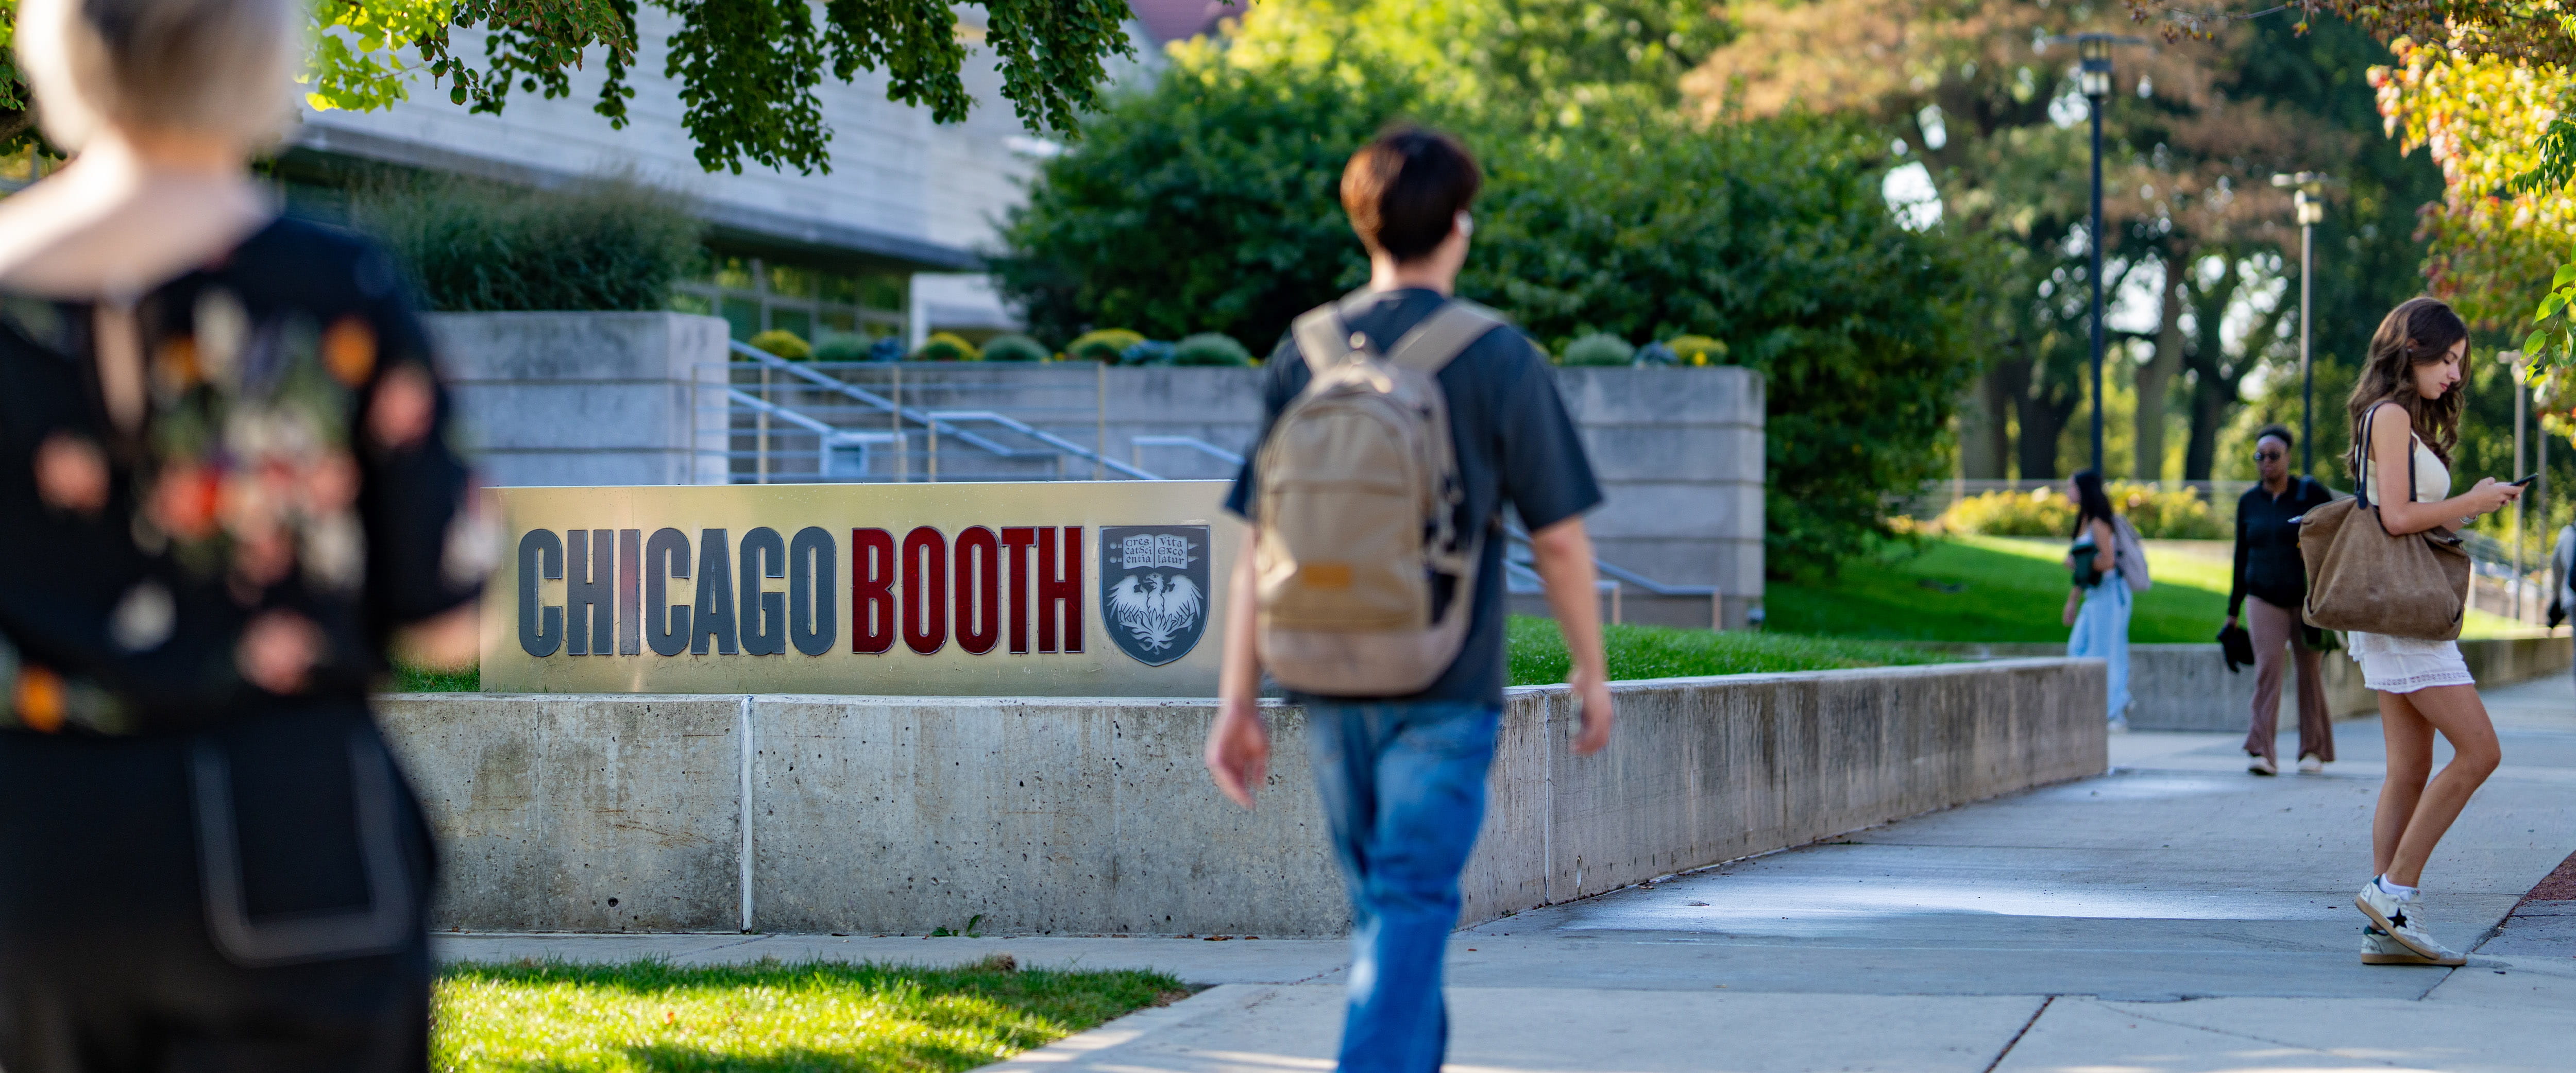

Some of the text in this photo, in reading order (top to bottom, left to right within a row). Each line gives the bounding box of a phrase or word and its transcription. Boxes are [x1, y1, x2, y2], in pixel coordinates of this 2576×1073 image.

[1158, 536, 1182, 547] Vita
[1126, 554, 1151, 564] entia
[1158, 555, 1184, 565] latur
[518, 525, 1084, 656] CHICAGO BOOTH
